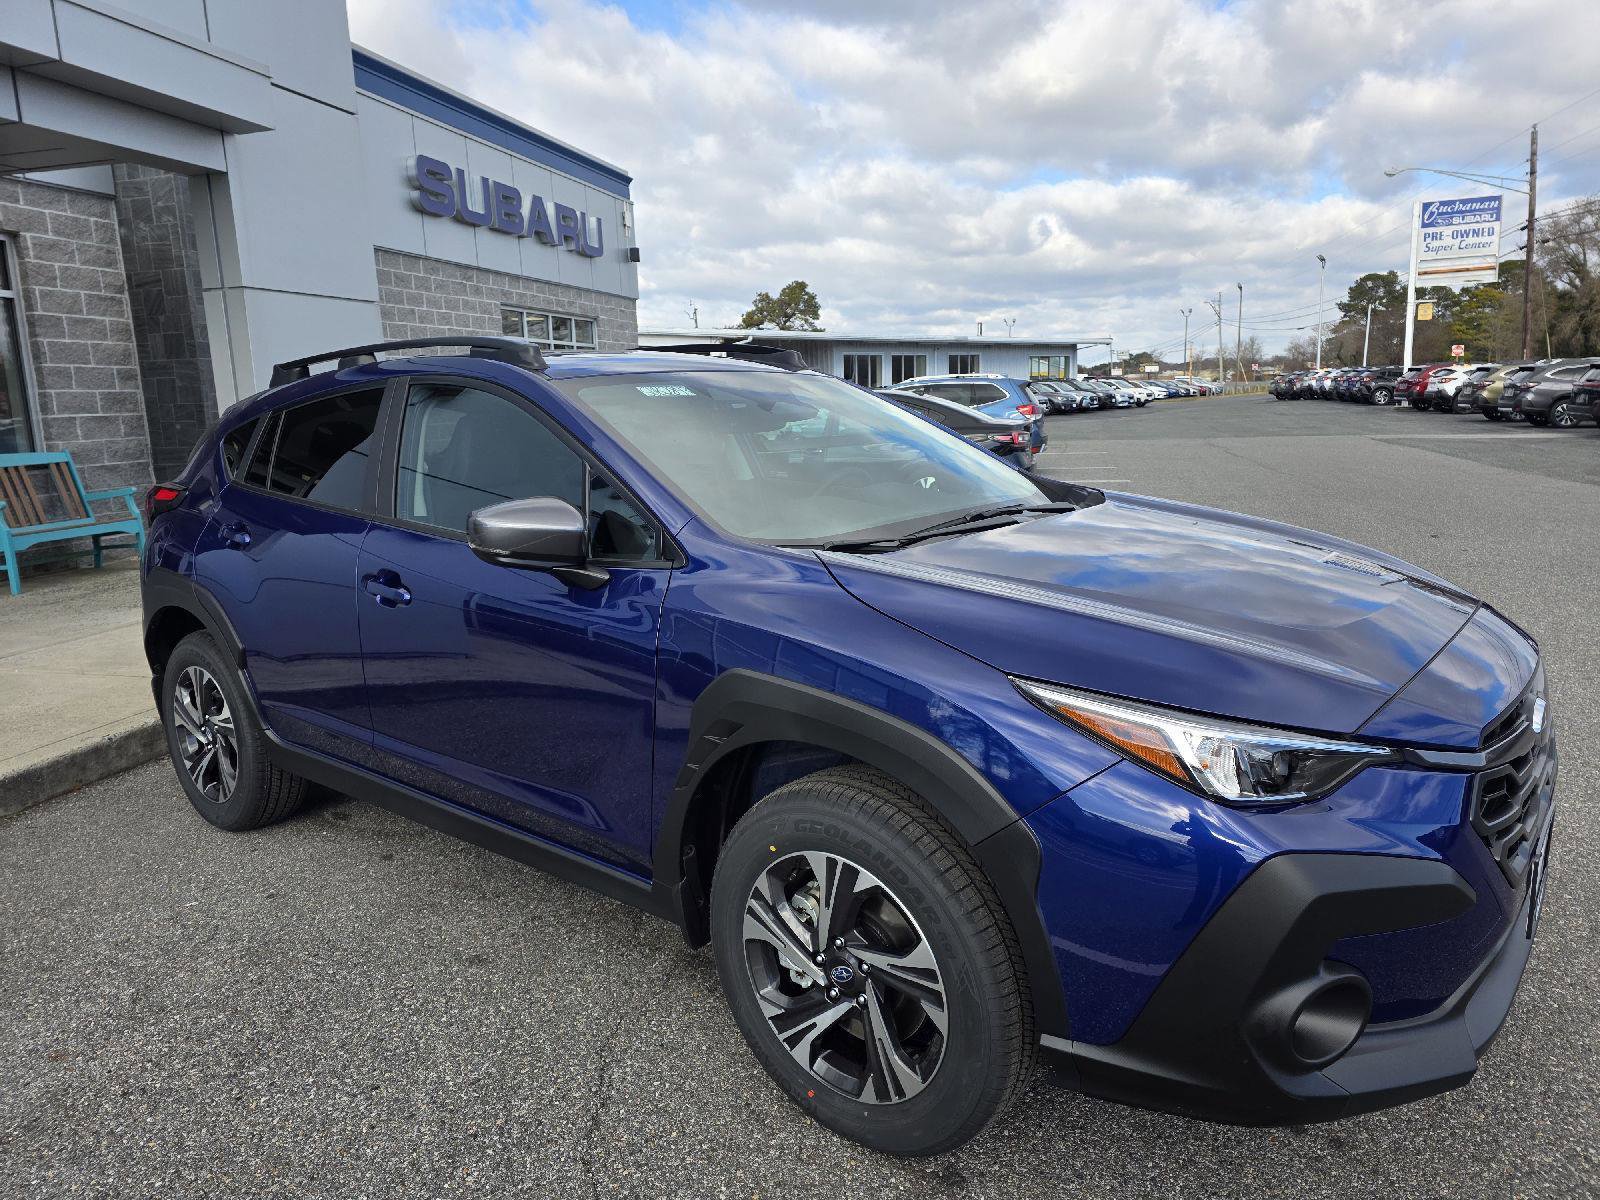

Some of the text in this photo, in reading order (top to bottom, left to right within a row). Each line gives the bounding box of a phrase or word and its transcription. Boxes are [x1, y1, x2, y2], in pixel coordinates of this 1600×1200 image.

[413, 154, 604, 257] SUBARU
[1424, 200, 1499, 223] Buchanan
[1452, 213, 1496, 224] SUBARU
[1423, 227, 1494, 242] PRE-OWNED
[1423, 239, 1493, 255] Super Center
